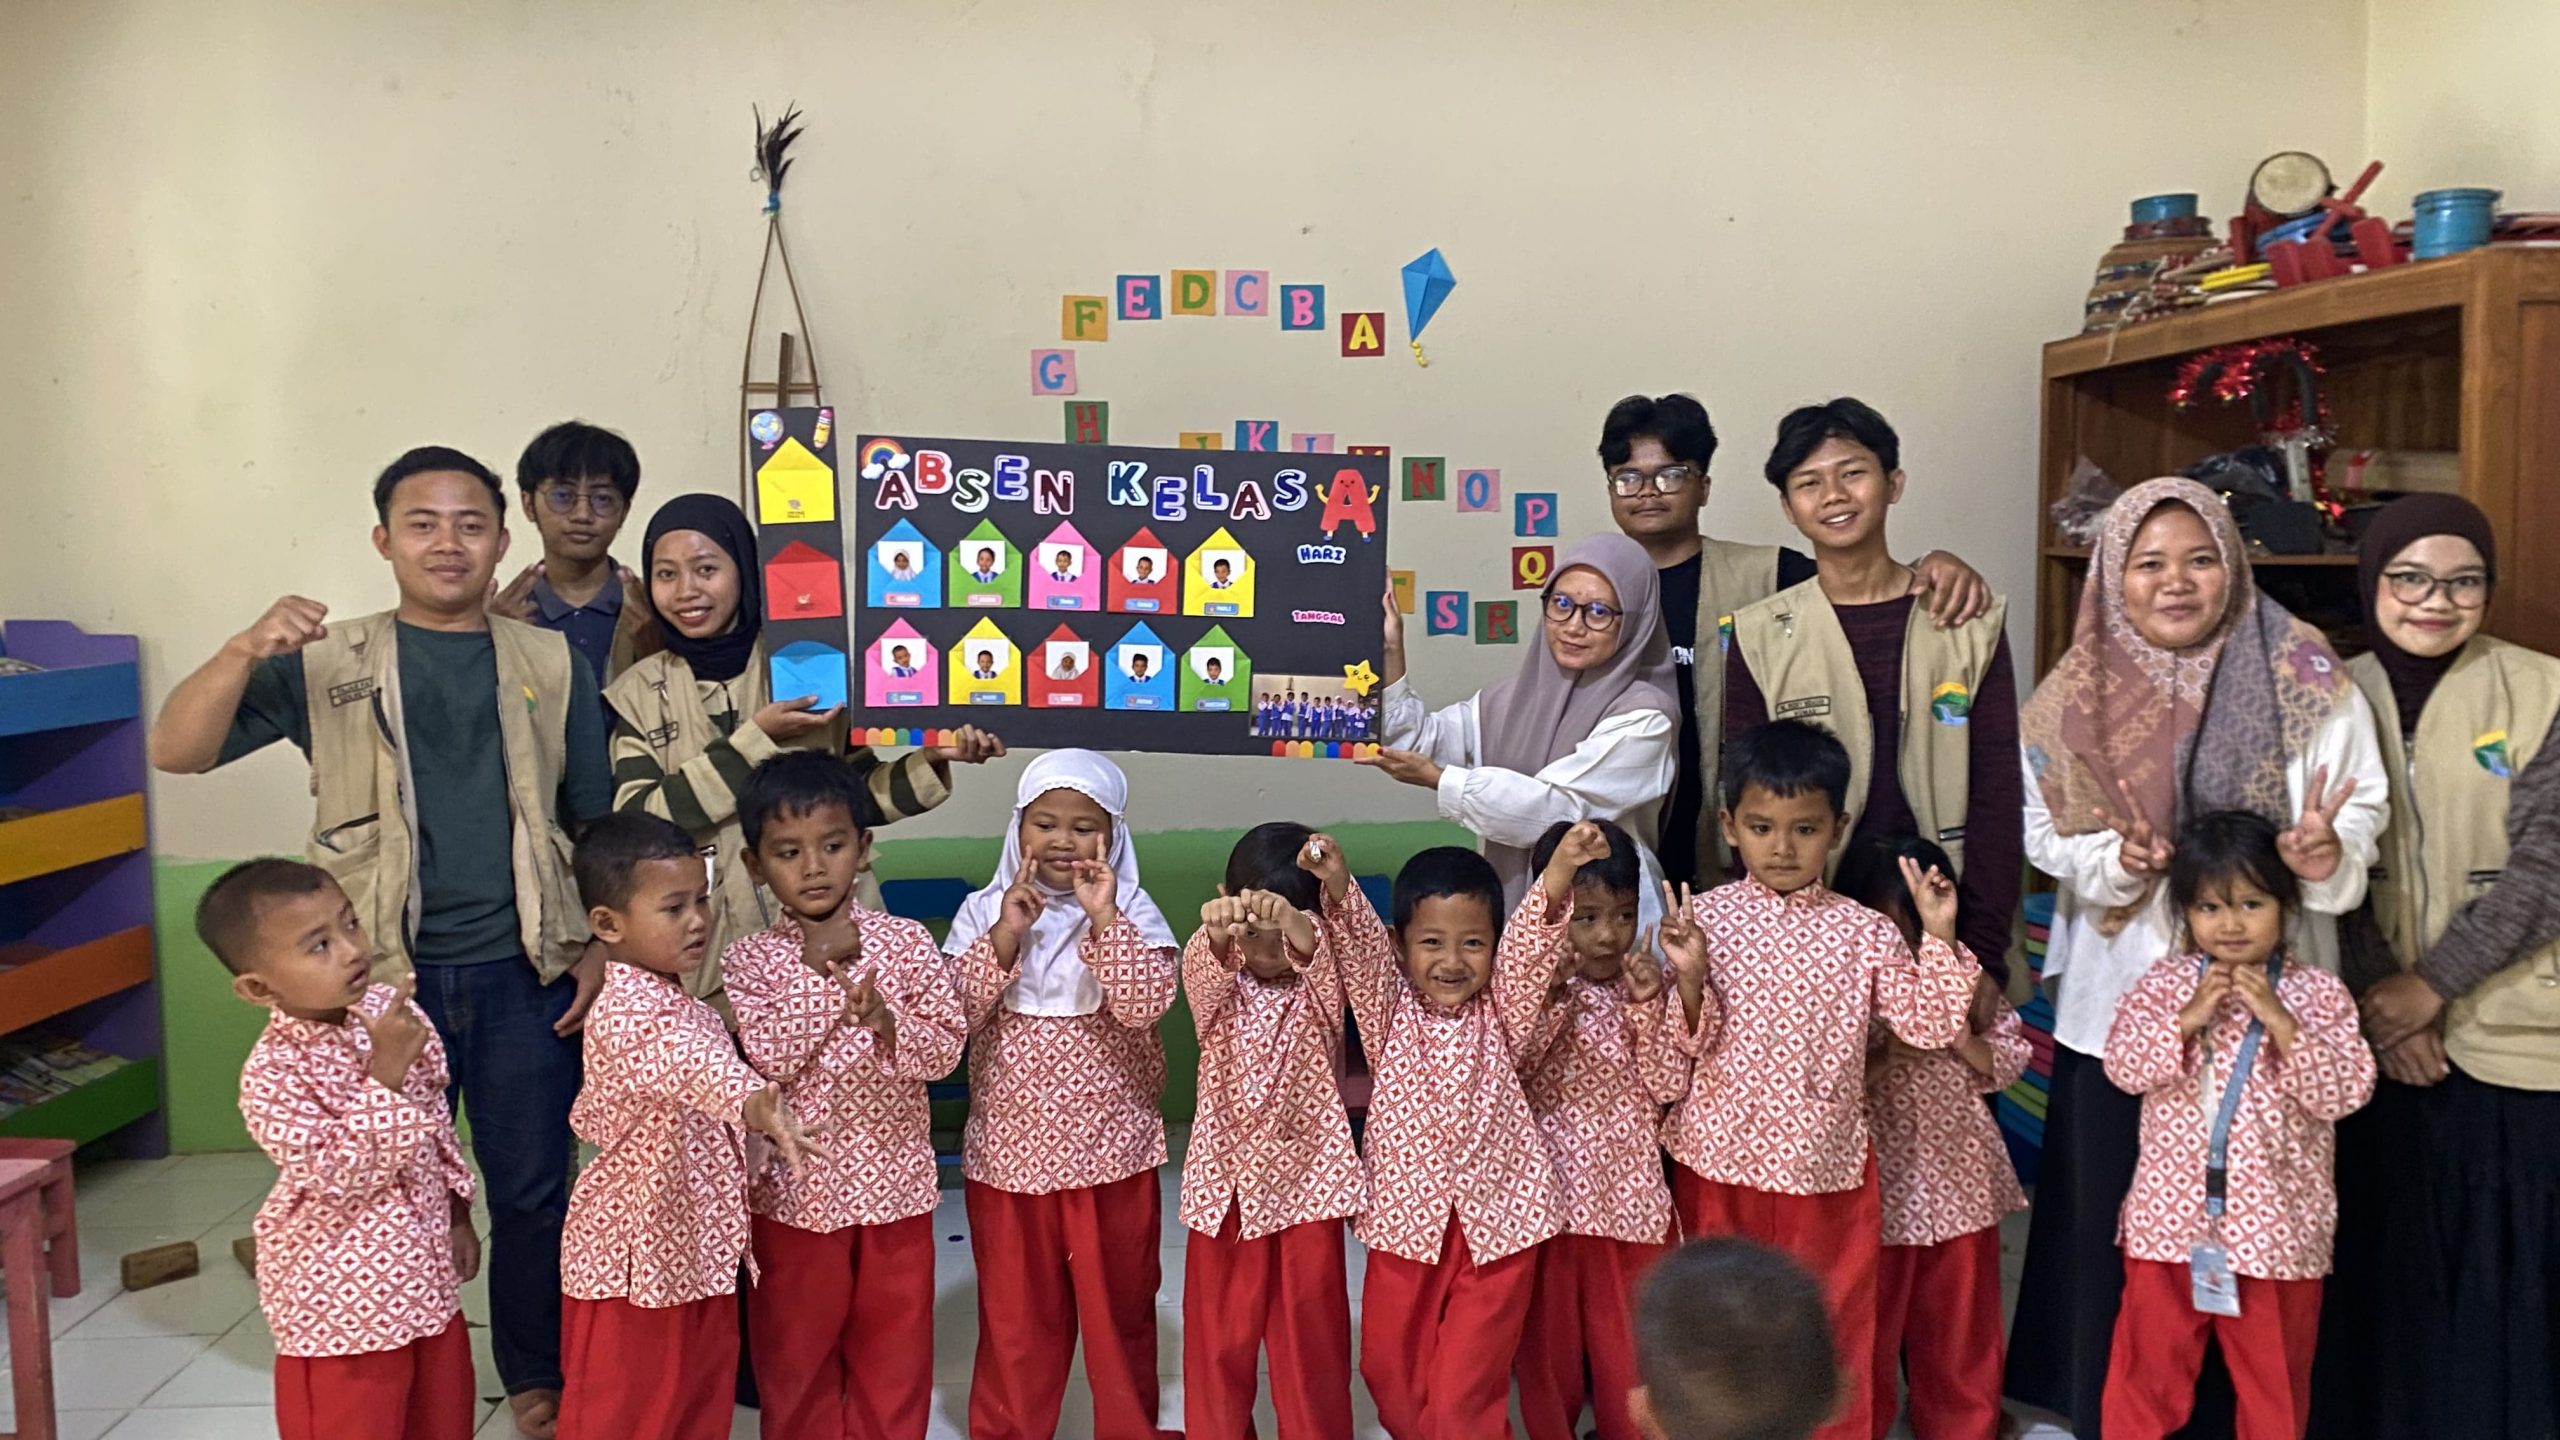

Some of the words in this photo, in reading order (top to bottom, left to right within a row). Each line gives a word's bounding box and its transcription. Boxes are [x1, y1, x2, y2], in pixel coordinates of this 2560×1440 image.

[1074, 300, 1103, 337] F
[1124, 278, 1152, 319] E
[1181, 274, 1210, 309] D
[1234, 274, 1259, 311] C
[1290, 288, 1315, 326] B
[1348, 313, 1379, 351] A
[1039, 353, 1067, 390] G
[1074, 404, 1102, 444] H
[1246, 422, 1271, 453] K
[875, 450, 1075, 516] ABSEN
[1107, 460, 1309, 522] KELAS
[1319, 469, 1377, 533] A
[1411, 461, 1437, 498] N
[1464, 471, 1490, 509] O
[1524, 498, 1550, 535] P
[1299, 545, 1345, 562] HARI
[1519, 551, 1547, 585] Q
[1293, 611, 1344, 623] TANGGAL
[1434, 594, 1459, 629] S
[1487, 603, 1513, 640] R
